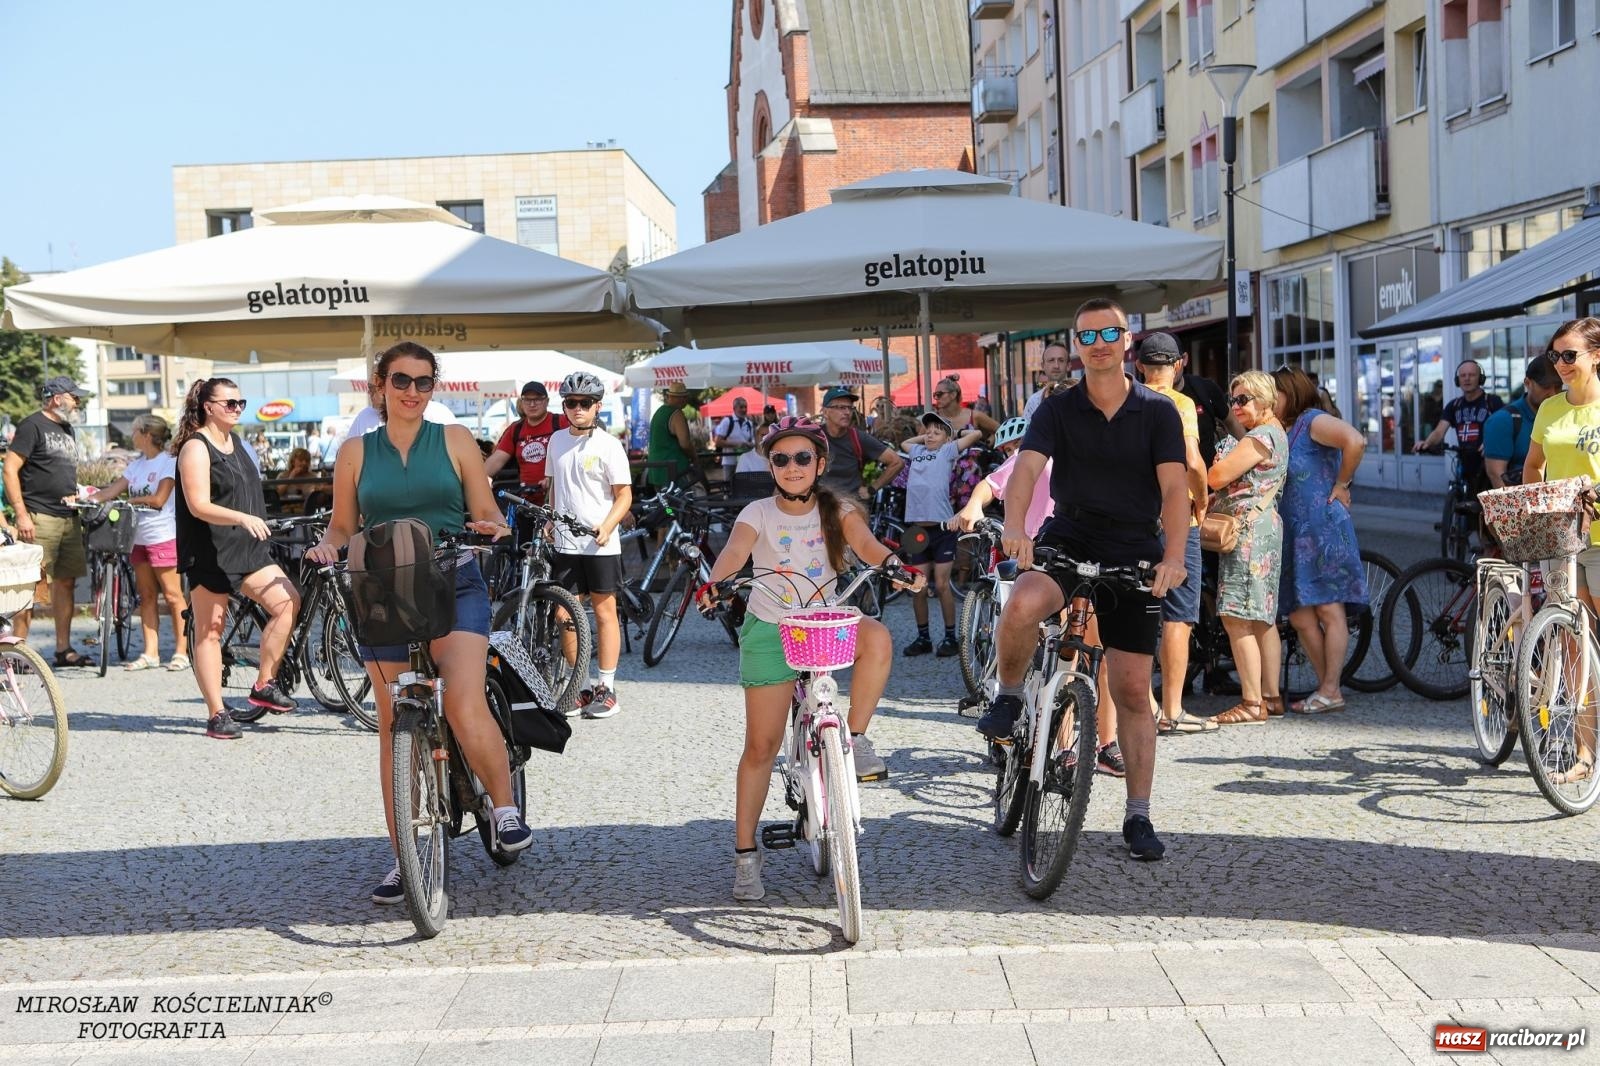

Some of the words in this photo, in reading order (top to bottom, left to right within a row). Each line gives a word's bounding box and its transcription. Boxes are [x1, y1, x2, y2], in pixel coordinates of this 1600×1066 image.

[864, 250, 986, 287] gelatopiu
[247, 279, 370, 313] gelatopiu
[1379, 267, 1412, 313] empik
[652, 366, 688, 378] ŻYWIEC
[746, 360, 793, 374] ŻYWIEC
